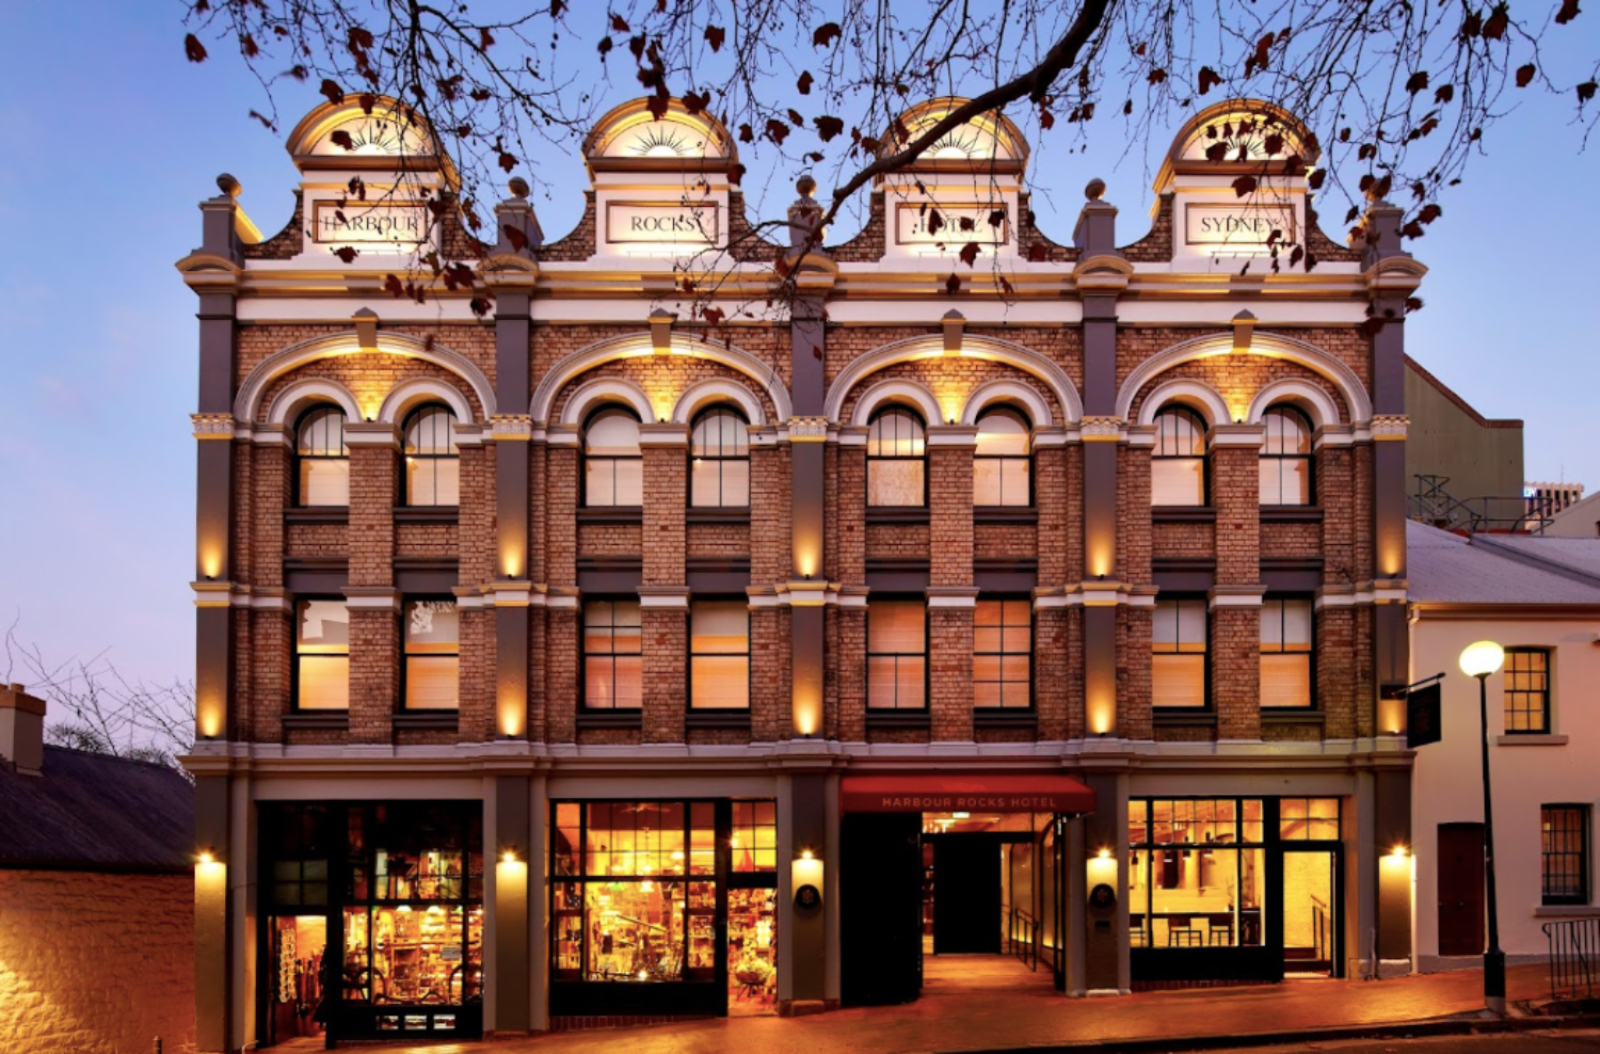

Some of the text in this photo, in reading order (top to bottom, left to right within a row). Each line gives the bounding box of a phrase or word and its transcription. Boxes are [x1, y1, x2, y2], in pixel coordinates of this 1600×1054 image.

[630, 215, 696, 232] ROCKS
[919, 216, 983, 233] HOTL
[1200, 216, 1276, 233] SYDNEY
[882, 797, 1056, 808] HARBOUR ROCKS HOTEL
